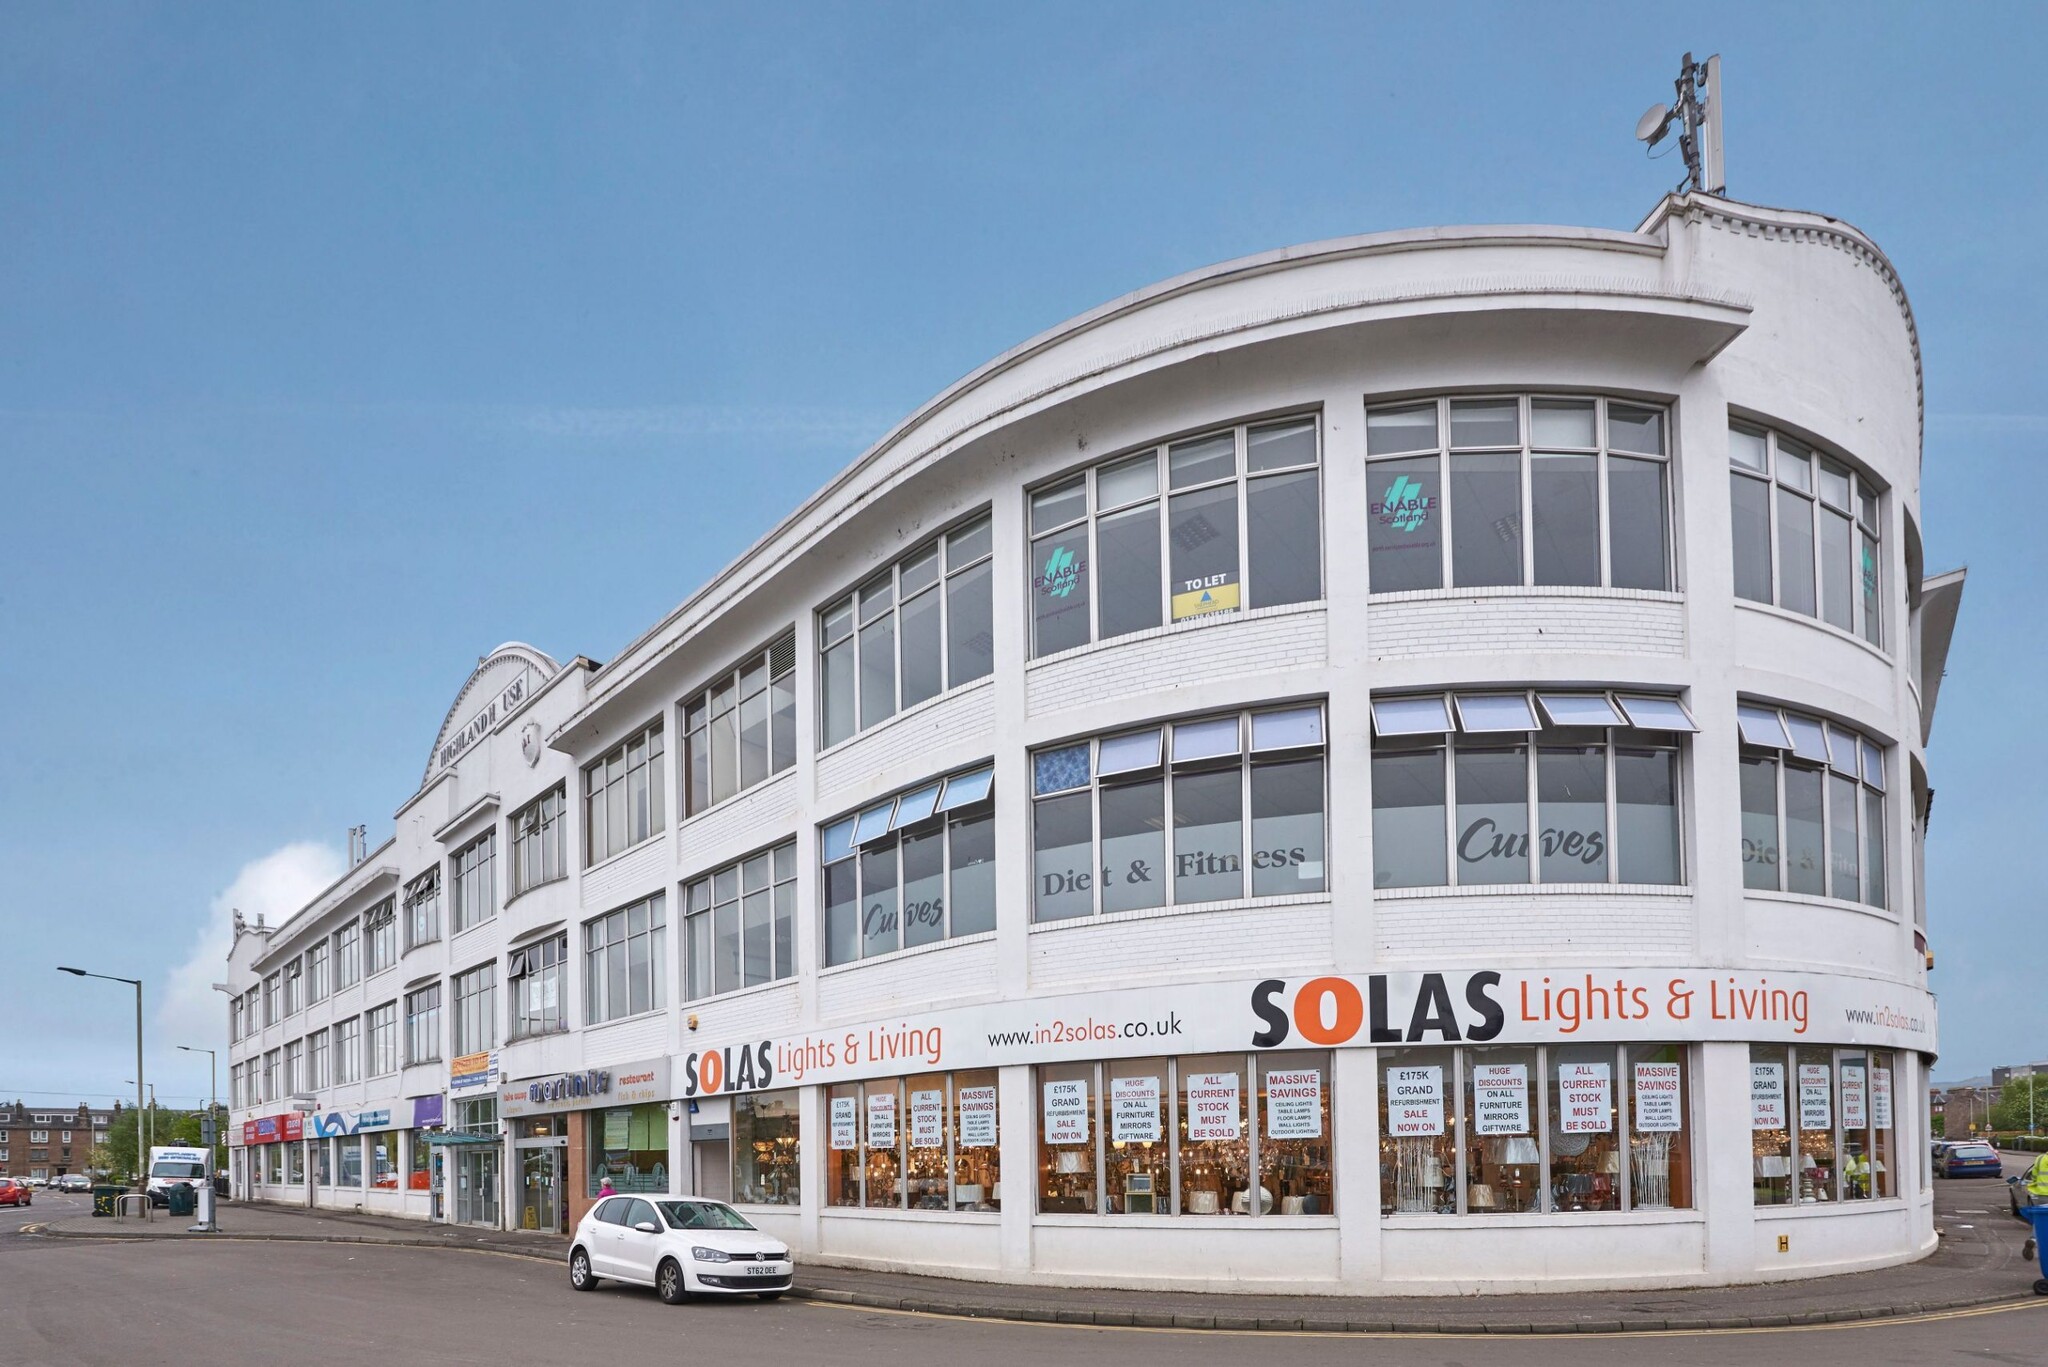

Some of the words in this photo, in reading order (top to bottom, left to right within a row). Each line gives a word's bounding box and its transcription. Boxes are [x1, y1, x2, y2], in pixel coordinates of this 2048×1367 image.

[1371, 497, 1437, 515] ENABLE
[1379, 511, 1428, 525] Scotland
[1034, 561, 1087, 588] ENABLE
[1041, 575, 1080, 596] Scotland
[1185, 579, 1202, 590] TO
[1205, 573, 1226, 587] LET
[1457, 817, 1604, 864] Curves
[1043, 865, 1112, 896] Diet
[1126, 859, 1152, 884] &
[1176, 847, 1306, 878] Fitness
[864, 898, 943, 940] Curves
[1251, 970, 1505, 1048] SOLAS
[1520, 974, 1649, 1033] Lights
[1667, 978, 1694, 1020] &
[1711, 977, 1808, 1034] Living
[1845, 1005, 1926, 1034] www.in2solas.co.uk
[988, 1011, 1182, 1047] www.in2solas.co.uk
[685, 1040, 773, 1097] SOLAS
[777, 1037, 835, 1081] Lights
[844, 1033, 860, 1065] &
[868, 1023, 942, 1065] Living
[1575, 1066, 1593, 1075] ALL
[1637, 1067, 1677, 1076] MASSIVE
[1755, 1067, 1774, 1075] £175K
[619, 1071, 654, 1085] restaurant
[1270, 1074, 1317, 1085] MASSIVE
[1400, 1071, 1429, 1080] £175K
[1204, 1077, 1221, 1085] ALL
[1563, 1080, 1607, 1089] CURRENT
[1638, 1081, 1677, 1090] SAVINGS
[1754, 1081, 1777, 1089] GRAND
[1842, 1081, 1863, 1089] CURRENT
[639, 1089, 655, 1099] chips
[1054, 1085, 1077, 1094] £175K
[1116, 1090, 1155, 1098] DISCOUNTS
[1191, 1089, 1235, 1098] CURRENT
[1270, 1088, 1317, 1098] SAVINGS
[1397, 1086, 1433, 1095] GRAND
[1487, 1090, 1499, 1098] ON
[962, 1090, 993, 1100] MASSIVE
[1569, 1093, 1601, 1102] STOCK
[962, 1102, 993, 1111] SAVINGS
[1052, 1098, 1080, 1107] GRAND
[1198, 1103, 1229, 1111] STOCK
[1480, 1101, 1522, 1109] FURNITURE
[913, 1104, 940, 1112] CURRENT
[1573, 1107, 1598, 1116] MUST
[1758, 1104, 1774, 1112] SALE
[1847, 1106, 1858, 1114] MUST
[1116, 1111, 1155, 1119] FURNITURE
[1404, 1110, 1427, 1118] SALE
[917, 1115, 936, 1123] STOCK
[1201, 1116, 1226, 1124] MUST
[919, 1126, 935, 1134] MUST
[1422, 1123, 1435, 1131] ON
[1482, 1124, 1521, 1132] GIFTWARE
[1566, 1122, 1578, 1130] BE
[1581, 1121, 1606, 1130] SOLD
[1052, 1132, 1069, 1140] NOW
[1118, 1132, 1153, 1140] GIFTWARE
[1209, 1129, 1234, 1137] SOLD
[1780, 1236, 1788, 1250] H
